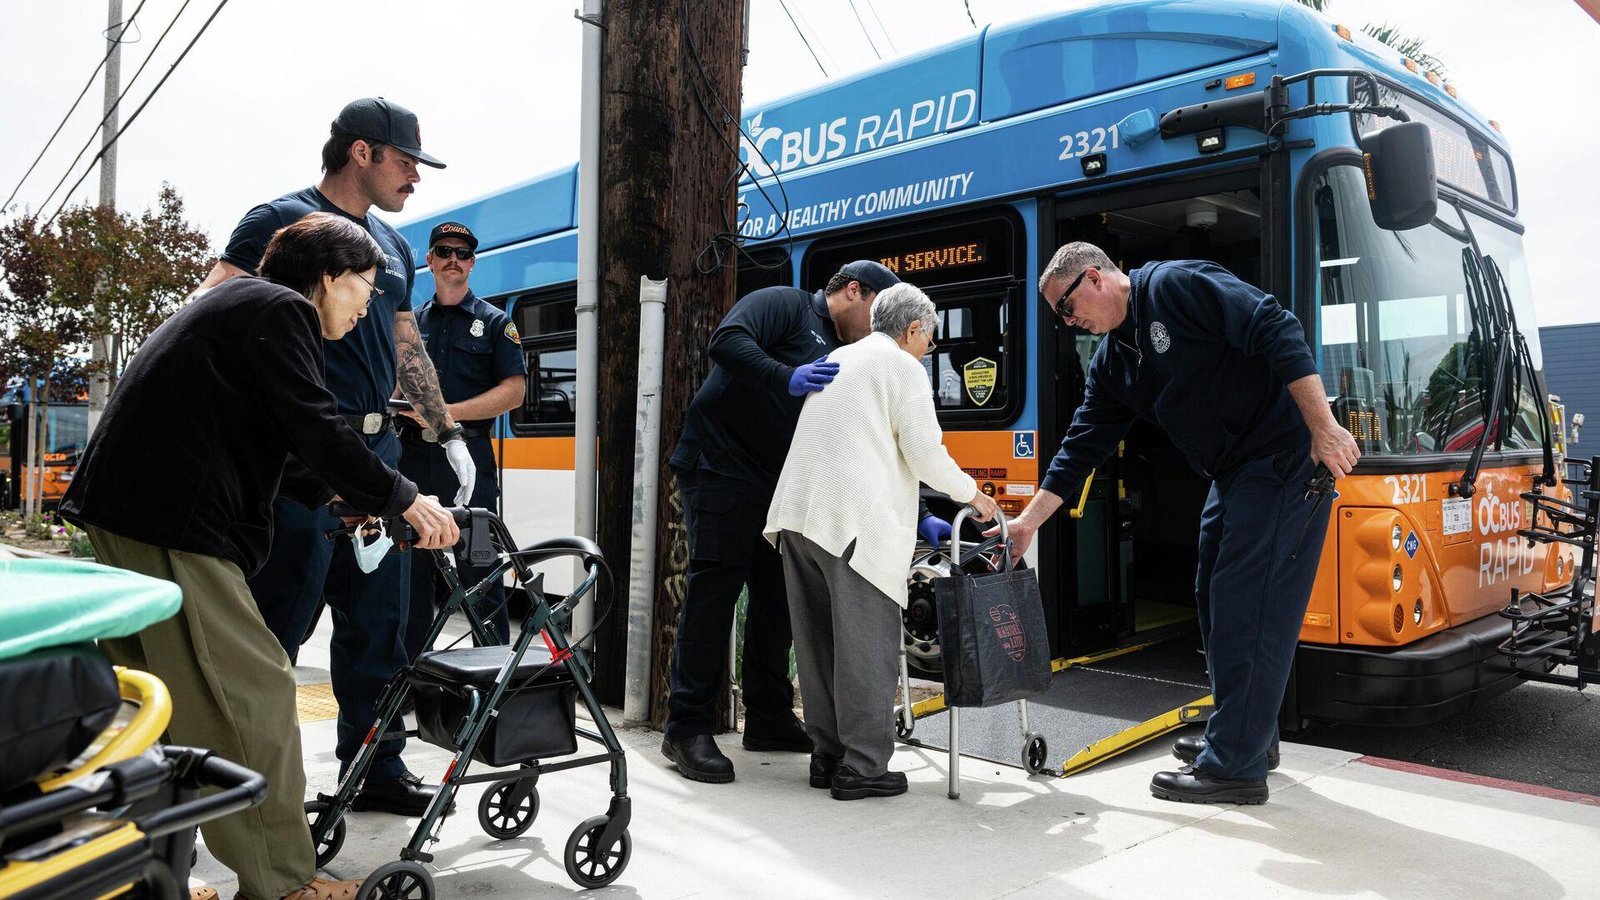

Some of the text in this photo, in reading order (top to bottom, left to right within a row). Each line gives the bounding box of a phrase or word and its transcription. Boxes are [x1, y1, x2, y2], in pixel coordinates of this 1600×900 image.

[854, 88, 977, 154] RAPID
[1058, 123, 1119, 161] 2321
[765, 213, 776, 235] A
[781, 197, 852, 232] HEALTHY
[854, 171, 975, 217] COMMUNITY
[880, 244, 982, 273] IN SERVICE.
[1384, 474, 1427, 505] 2321
[1406, 539, 1417, 551] CNG
[1479, 536, 1535, 589] RAPID
